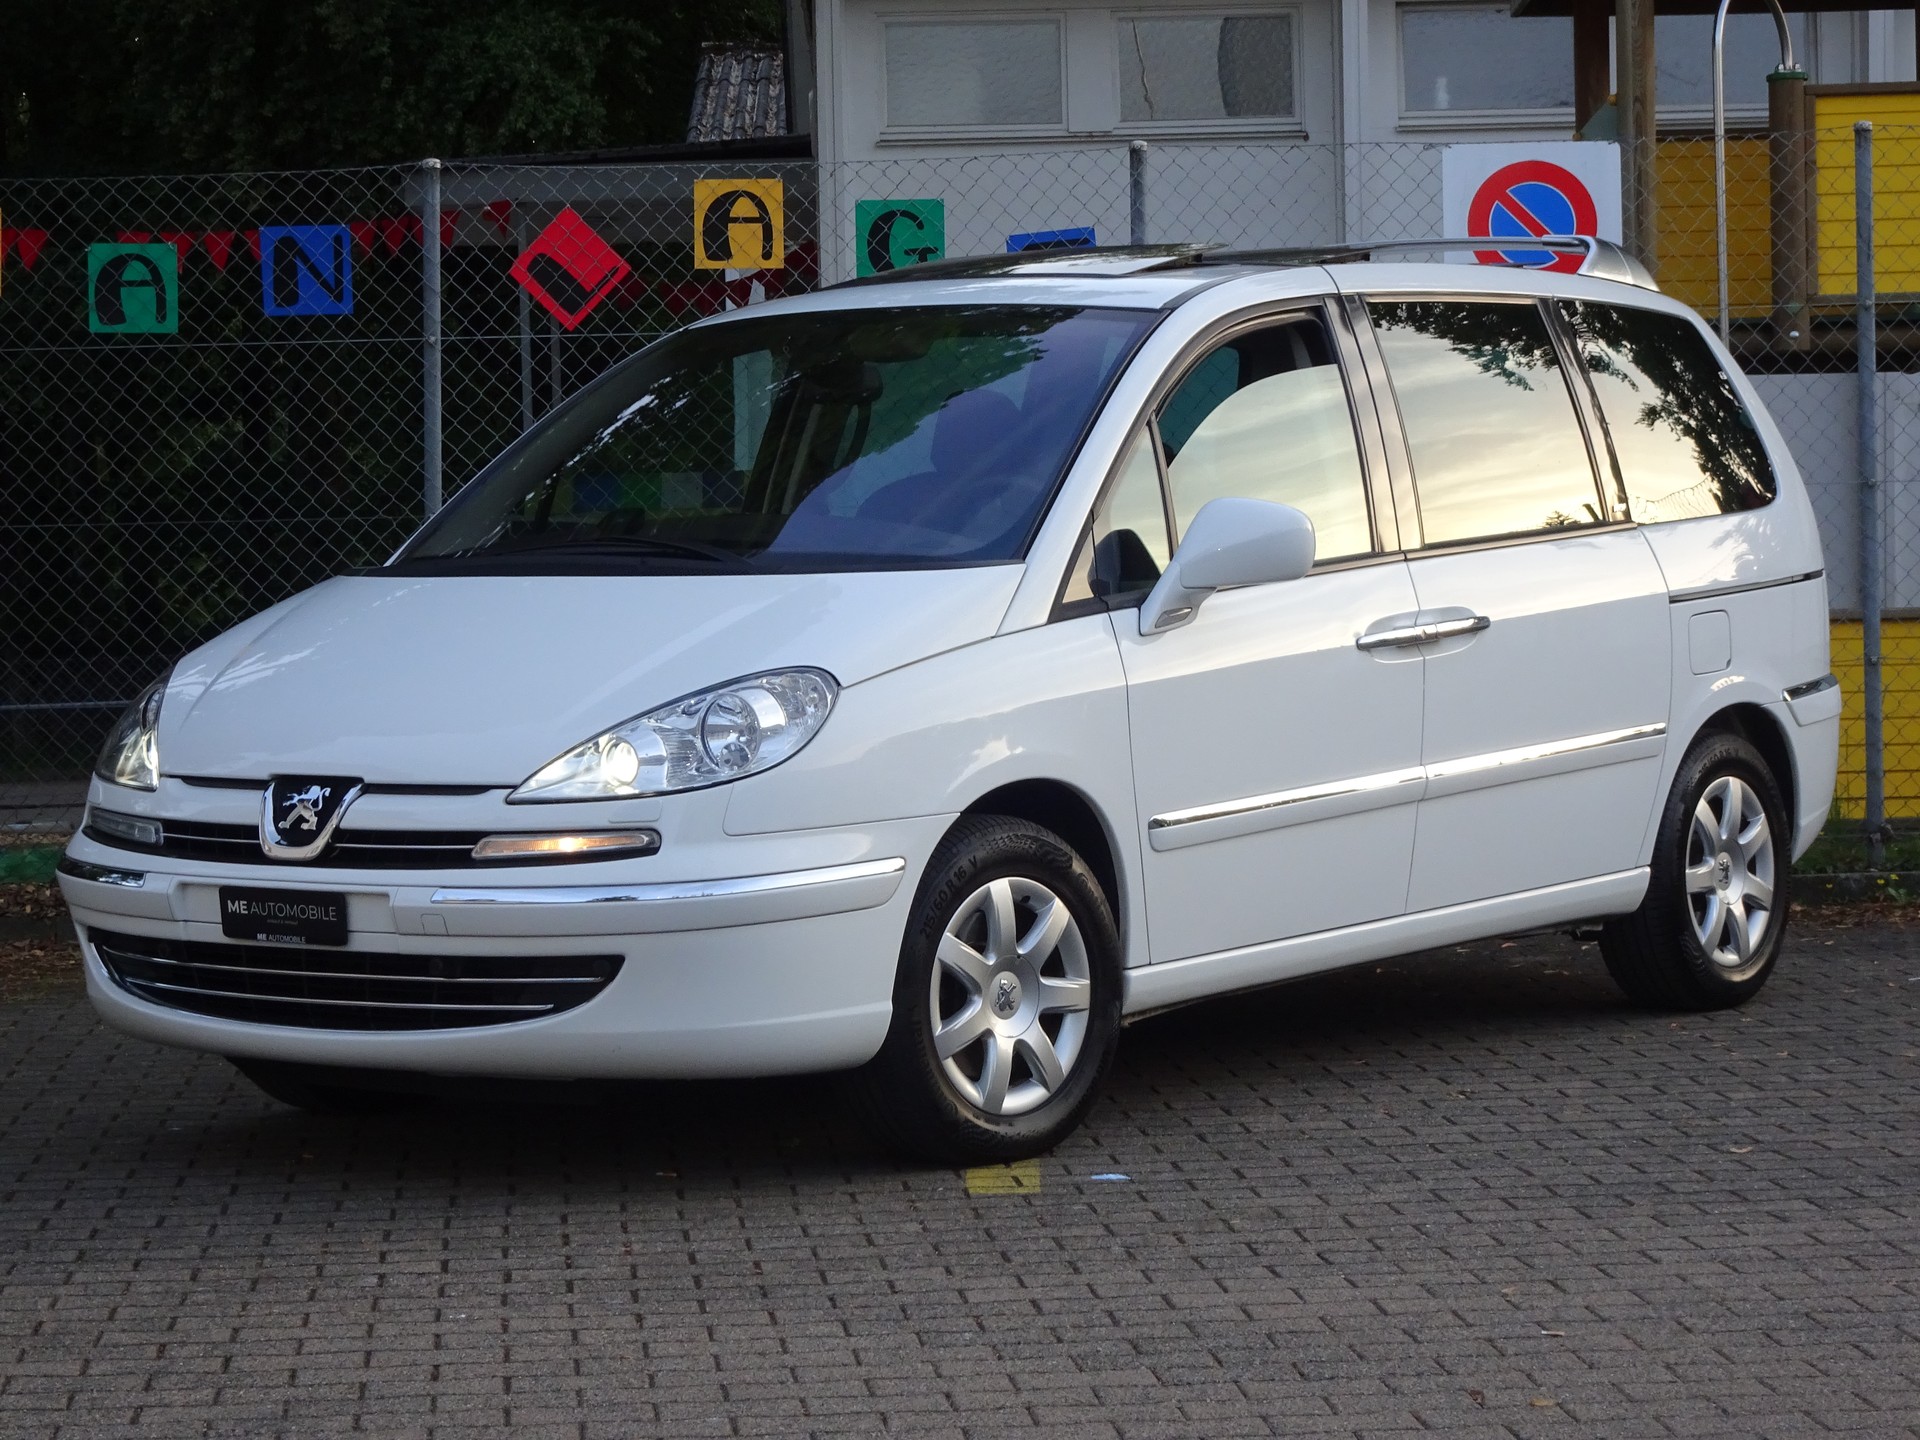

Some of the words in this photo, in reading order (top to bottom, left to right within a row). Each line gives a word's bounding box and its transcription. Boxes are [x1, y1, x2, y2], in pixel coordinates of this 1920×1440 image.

[95, 253, 167, 325] A
[273, 234, 343, 308] N
[702, 189, 774, 262] A
[227, 900, 248, 914] ME
[250, 901, 337, 921] AUTOMOBILE
[257, 933, 267, 941] ME
[268, 934, 306, 944] AUTOMOBILE
